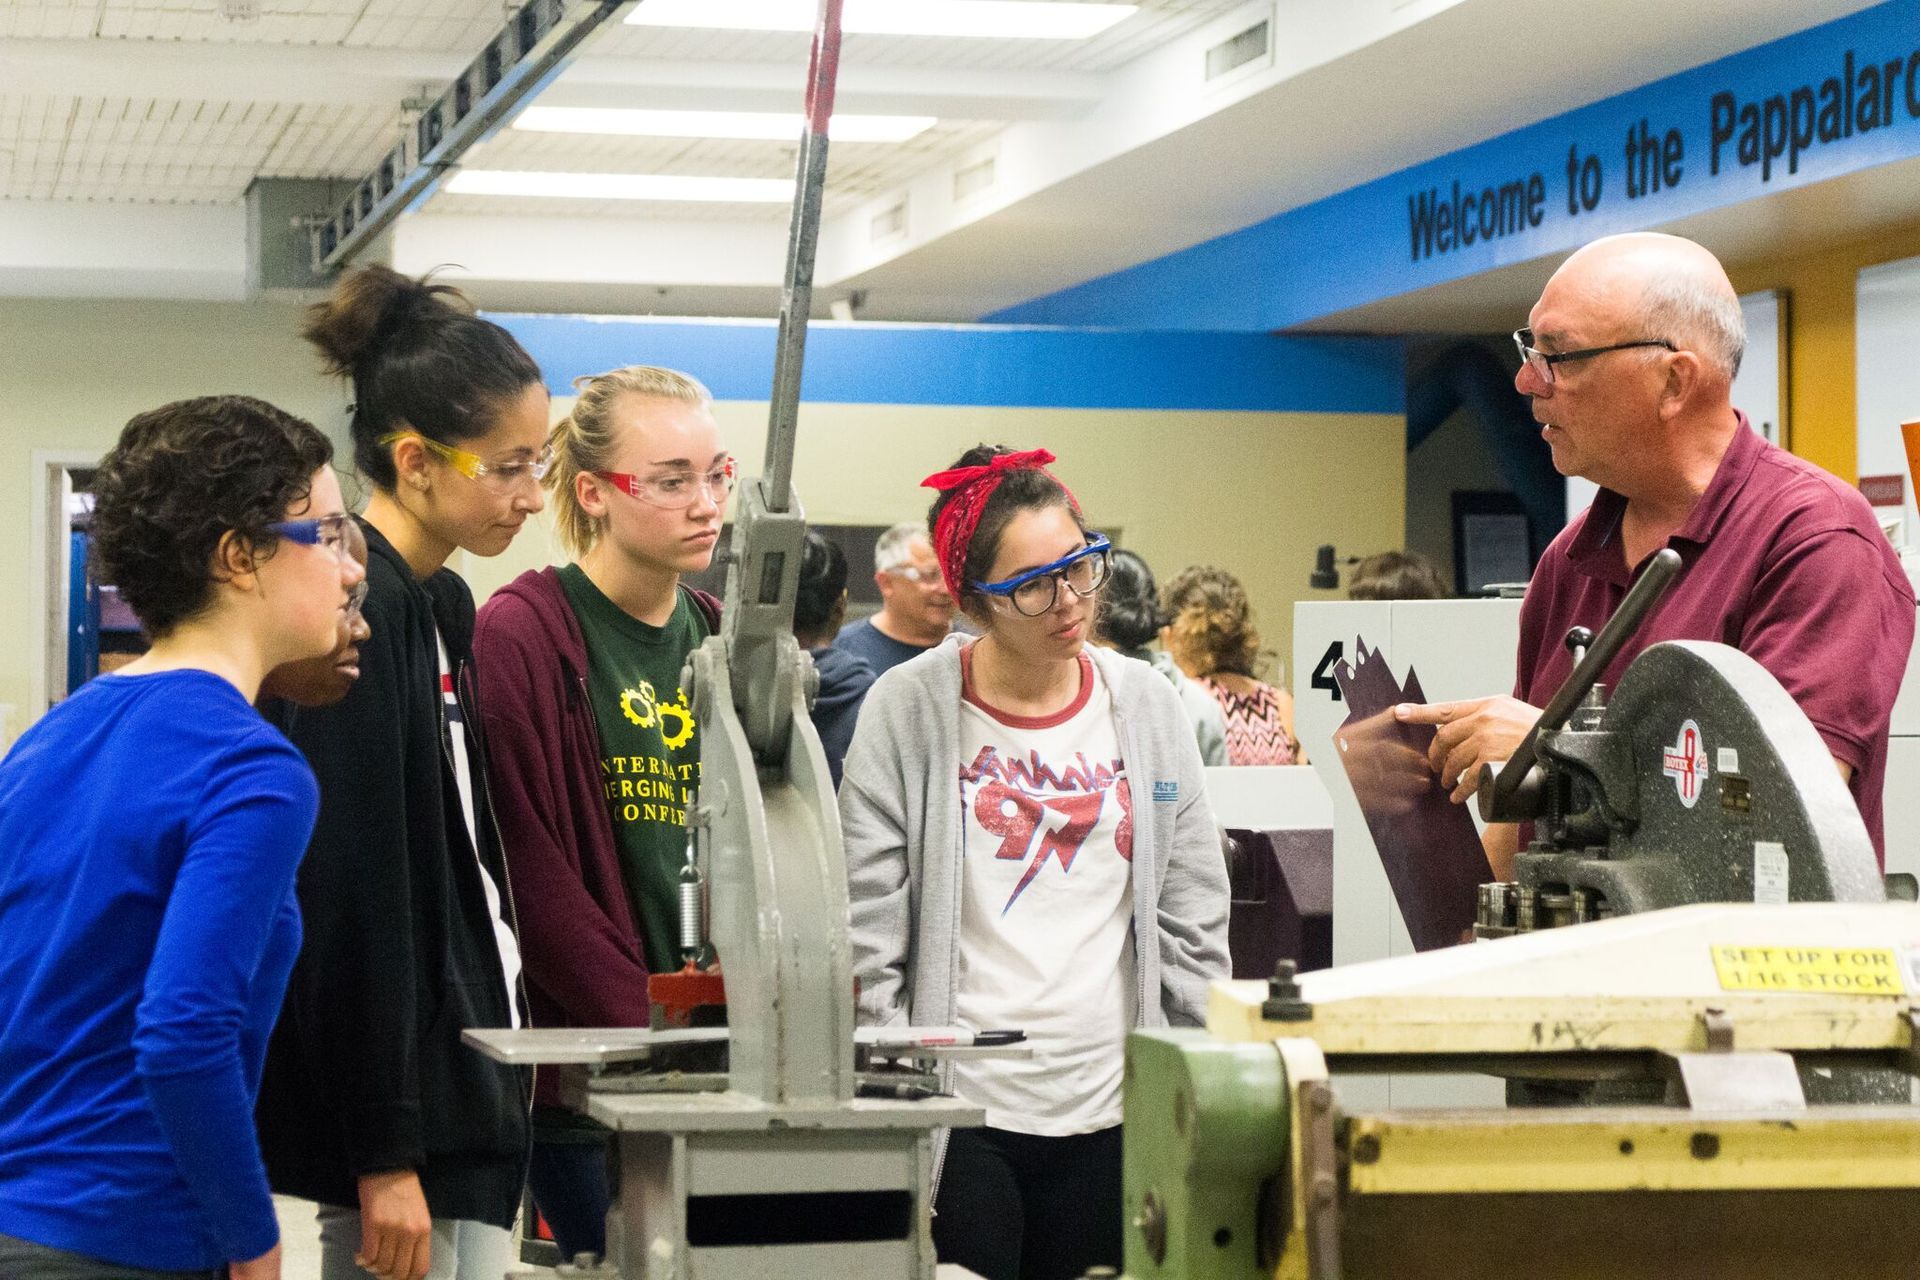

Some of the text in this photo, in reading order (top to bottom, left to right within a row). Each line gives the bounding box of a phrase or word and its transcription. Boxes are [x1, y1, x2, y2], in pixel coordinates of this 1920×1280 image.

[1407, 170, 1546, 262] Welcome
[1566, 142, 1602, 216] to
[1625, 118, 1684, 200] the
[1311, 640, 1344, 701] 4
[1721, 948, 1889, 966] SET UP FOR
[1797, 972, 1892, 988] STOCK
